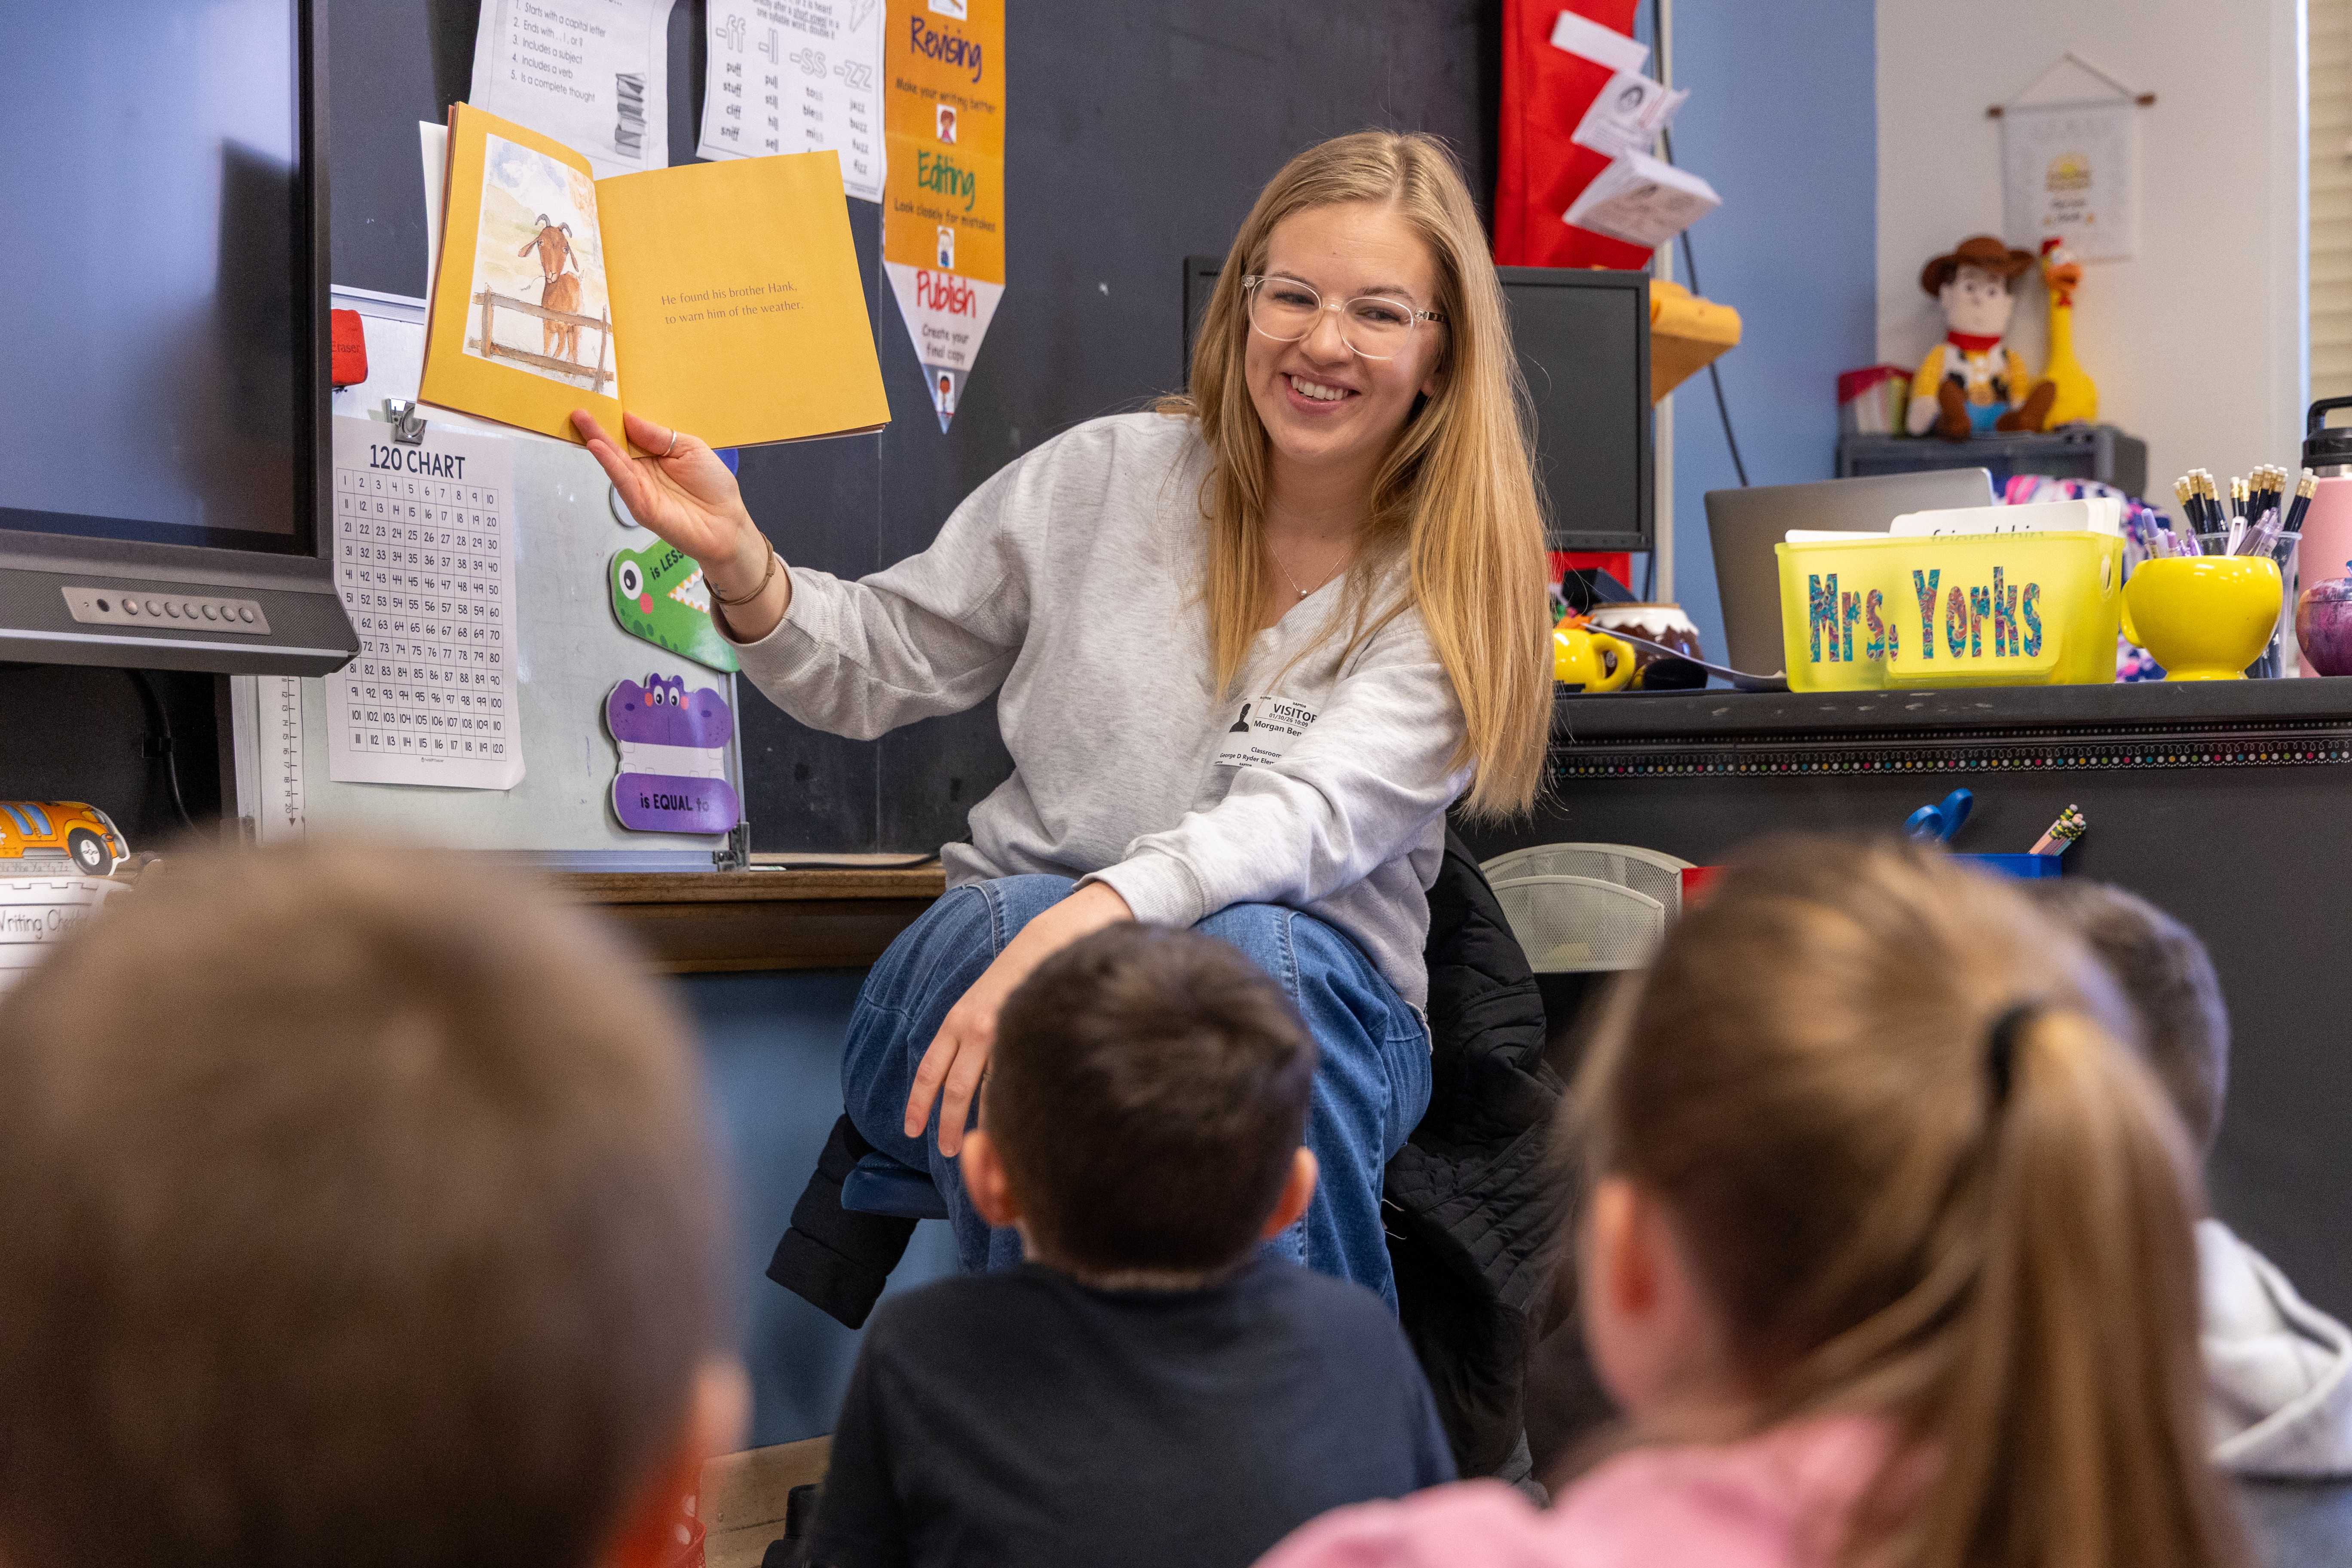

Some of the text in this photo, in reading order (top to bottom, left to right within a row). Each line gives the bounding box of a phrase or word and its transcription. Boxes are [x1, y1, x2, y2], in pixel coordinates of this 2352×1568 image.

[514, 16, 520, 28] 2.
[524, 20, 539, 34] Ends
[540, 26, 554, 39] with
[525, 2, 543, 18] Starts
[544, 9, 557, 21] with
[559, 15, 564, 24] a
[565, 18, 588, 32] capital
[589, 23, 606, 38] letter
[513, 34, 519, 46] 3.
[523, 37, 551, 55] Includes
[553, 49, 557, 57] a
[559, 49, 582, 64] subject
[910, 15, 982, 84] Revising
[512, 52, 573, 79] 4. Includes a verb
[511, 69, 595, 103] 5. Is a complete thought
[918, 149, 976, 212] Editing
[662, 282, 798, 306] He found his brother Hank,
[916, 270, 976, 318] Publish
[665, 301, 804, 324] to warn him of the weather.
[921, 323, 969, 344] Create your
[948, 350, 965, 363] copy
[370, 444, 466, 480] 120 CHART
[344, 475, 494, 504] 1 2 3 4 5 6 7 8 9 10
[344, 522, 497, 550] 21 22 23 24 25 26 27 28 29 30
[346, 569, 499, 595] 41 42 43 44 45 46 47 48 49 50
[650, 567, 661, 580] is
[1808, 566, 2043, 663] Mrs. Yorks
[1253, 720, 1285, 732] Morgan
[1269, 713, 1308, 728] 01/30/26 10:09
[371, 735, 380, 745] 112
[387, 736, 395, 746] 113
[403, 737, 411, 747] 114
[419, 738, 427, 748] 115
[435, 739, 444, 749] 116
[479, 742, 488, 752] 119
[493, 744, 504, 754] 120
[285, 804, 291, 814] 20
[640, 793, 710, 812] is EQUAL to
